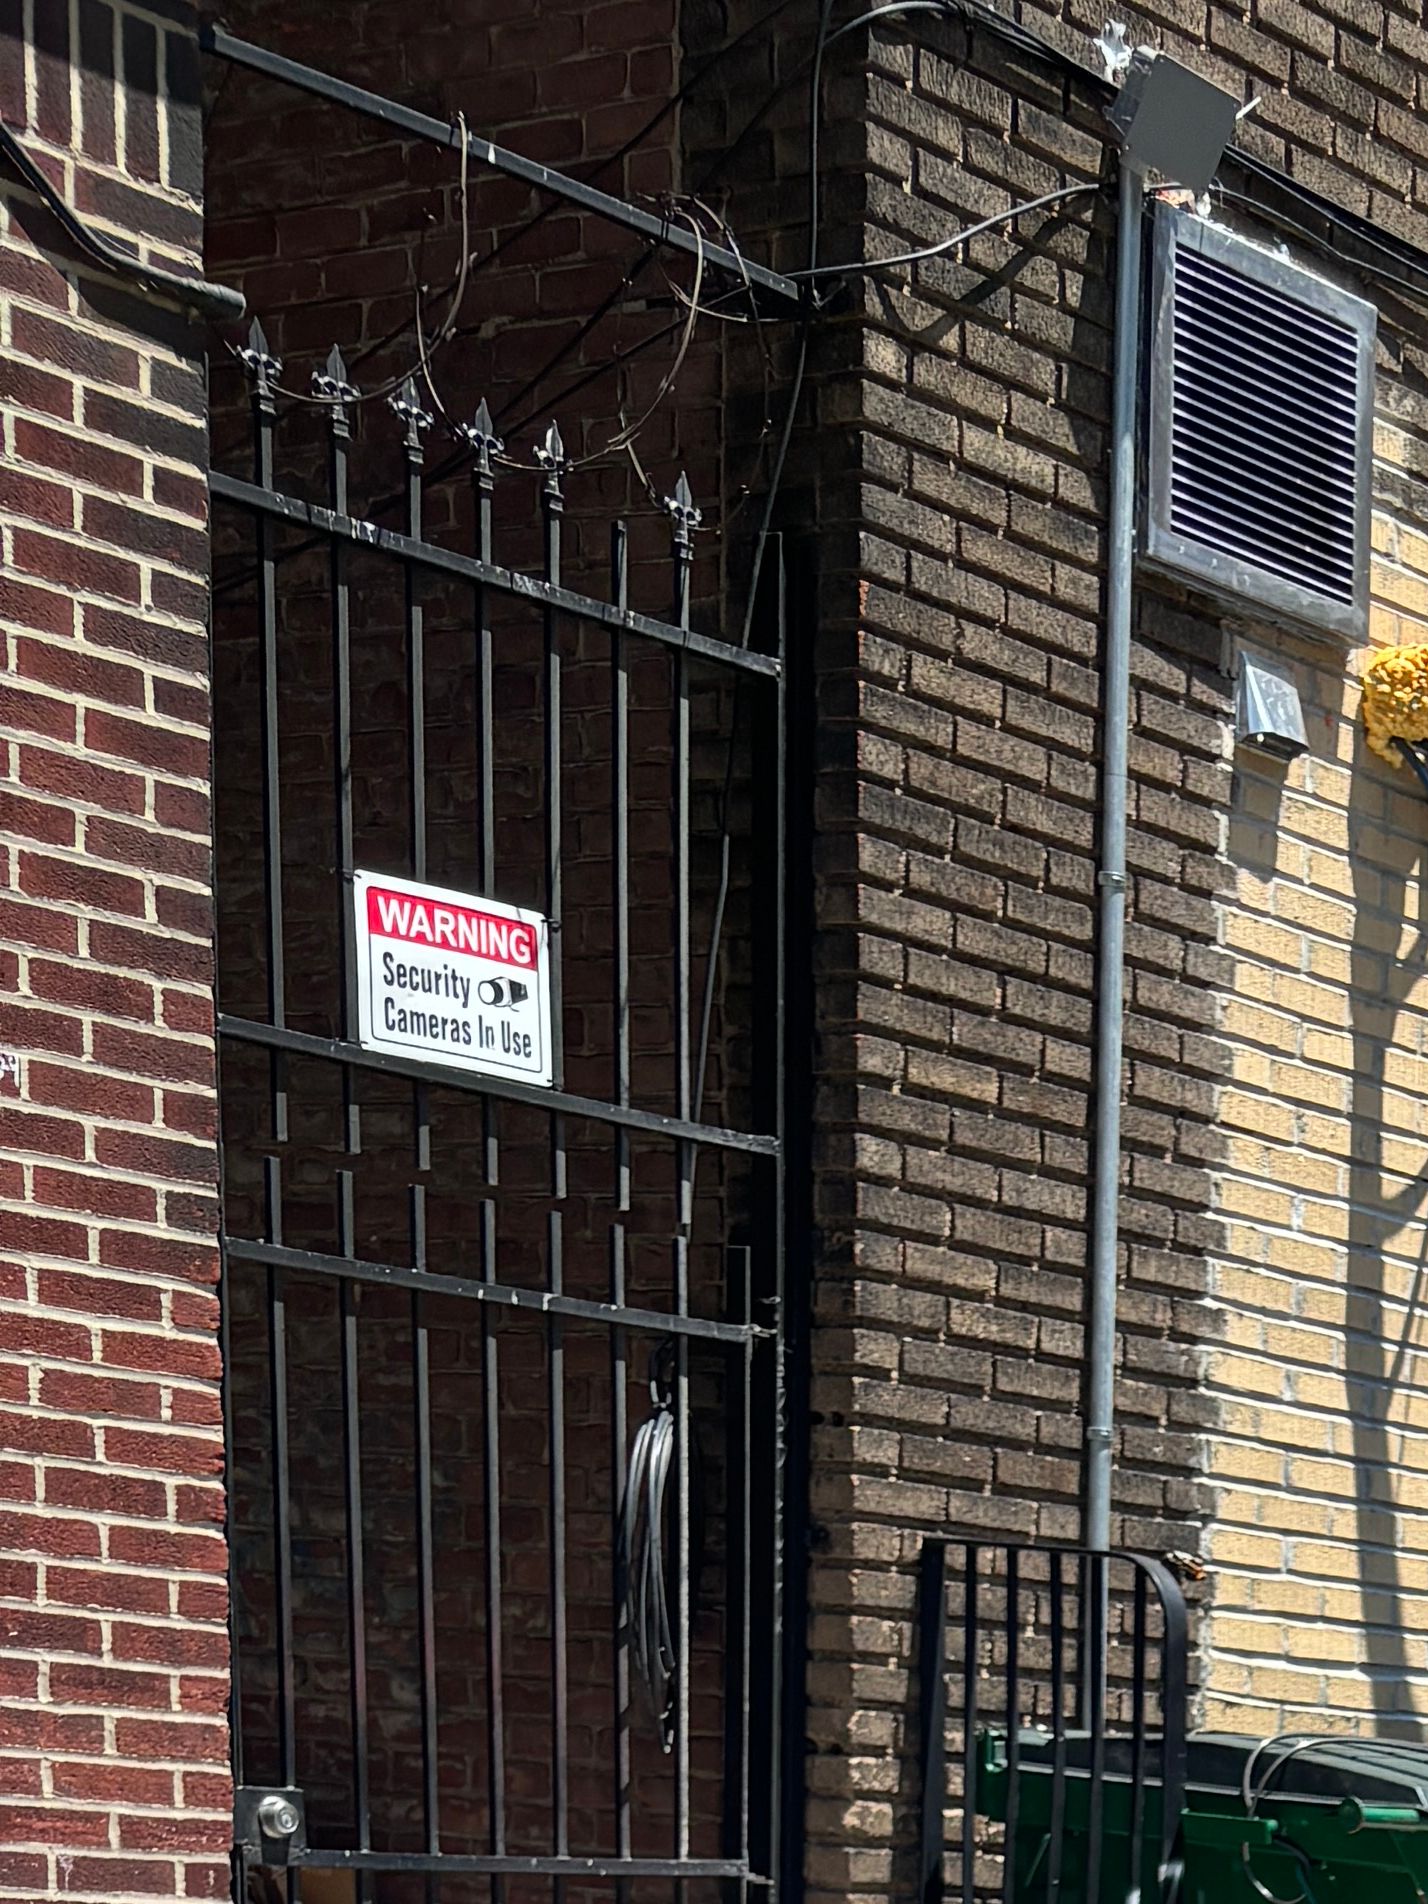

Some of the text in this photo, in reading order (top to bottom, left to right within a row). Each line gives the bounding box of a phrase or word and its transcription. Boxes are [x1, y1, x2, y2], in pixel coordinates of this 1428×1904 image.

[377, 895, 532, 965] WARNING
[382, 951, 471, 1009] Security
[383, 996, 532, 1059] Cameras In Use
